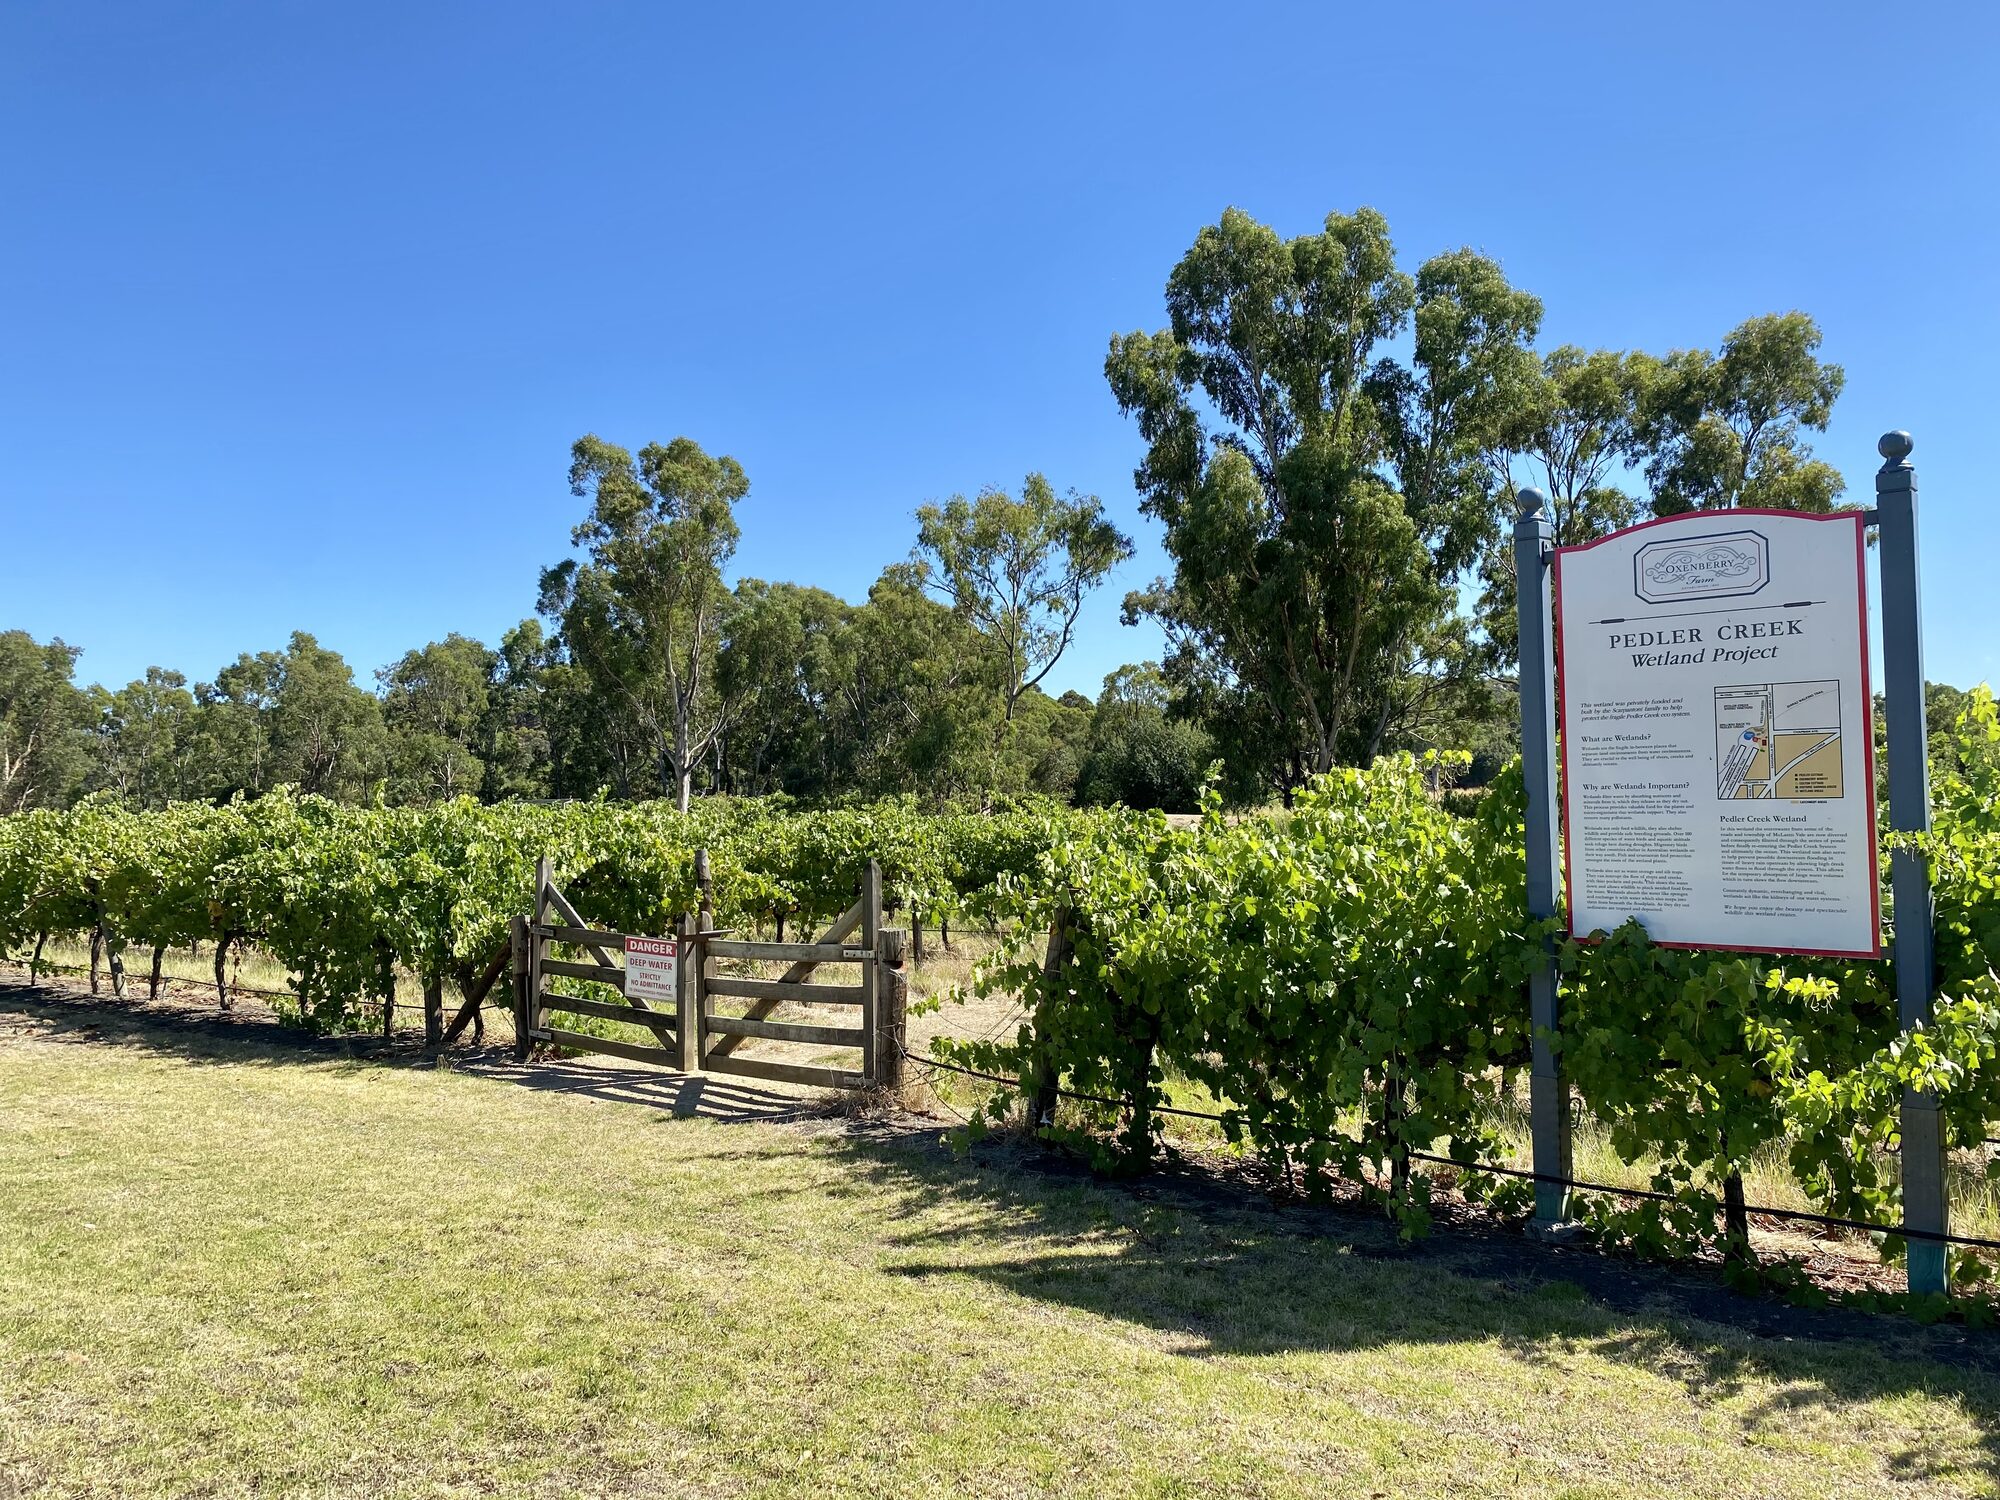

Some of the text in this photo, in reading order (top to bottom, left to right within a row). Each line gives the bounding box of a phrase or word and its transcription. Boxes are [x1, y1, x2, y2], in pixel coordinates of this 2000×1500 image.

[1665, 560, 1734, 574] OXENBERRY
[1686, 575, 1714, 585] Farm
[1609, 619, 1804, 649] PEDLER CREEK
[1632, 645, 1779, 668] Wetland Project
[1626, 699, 1650, 707] privately
[1593, 708, 1601, 716] by
[1644, 705, 1661, 713] family
[1669, 703, 1683, 712] help
[1581, 714, 1600, 723] protect
[1609, 713, 1626, 721] fragile
[1583, 784, 1598, 792] Why
[1648, 782, 1690, 791] Important?
[630, 940, 672, 955] DANGER
[630, 958, 672, 970] DEEP WATER
[640, 972, 661, 981] STRICTLY
[640, 980, 672, 991] ADMITTANCE
